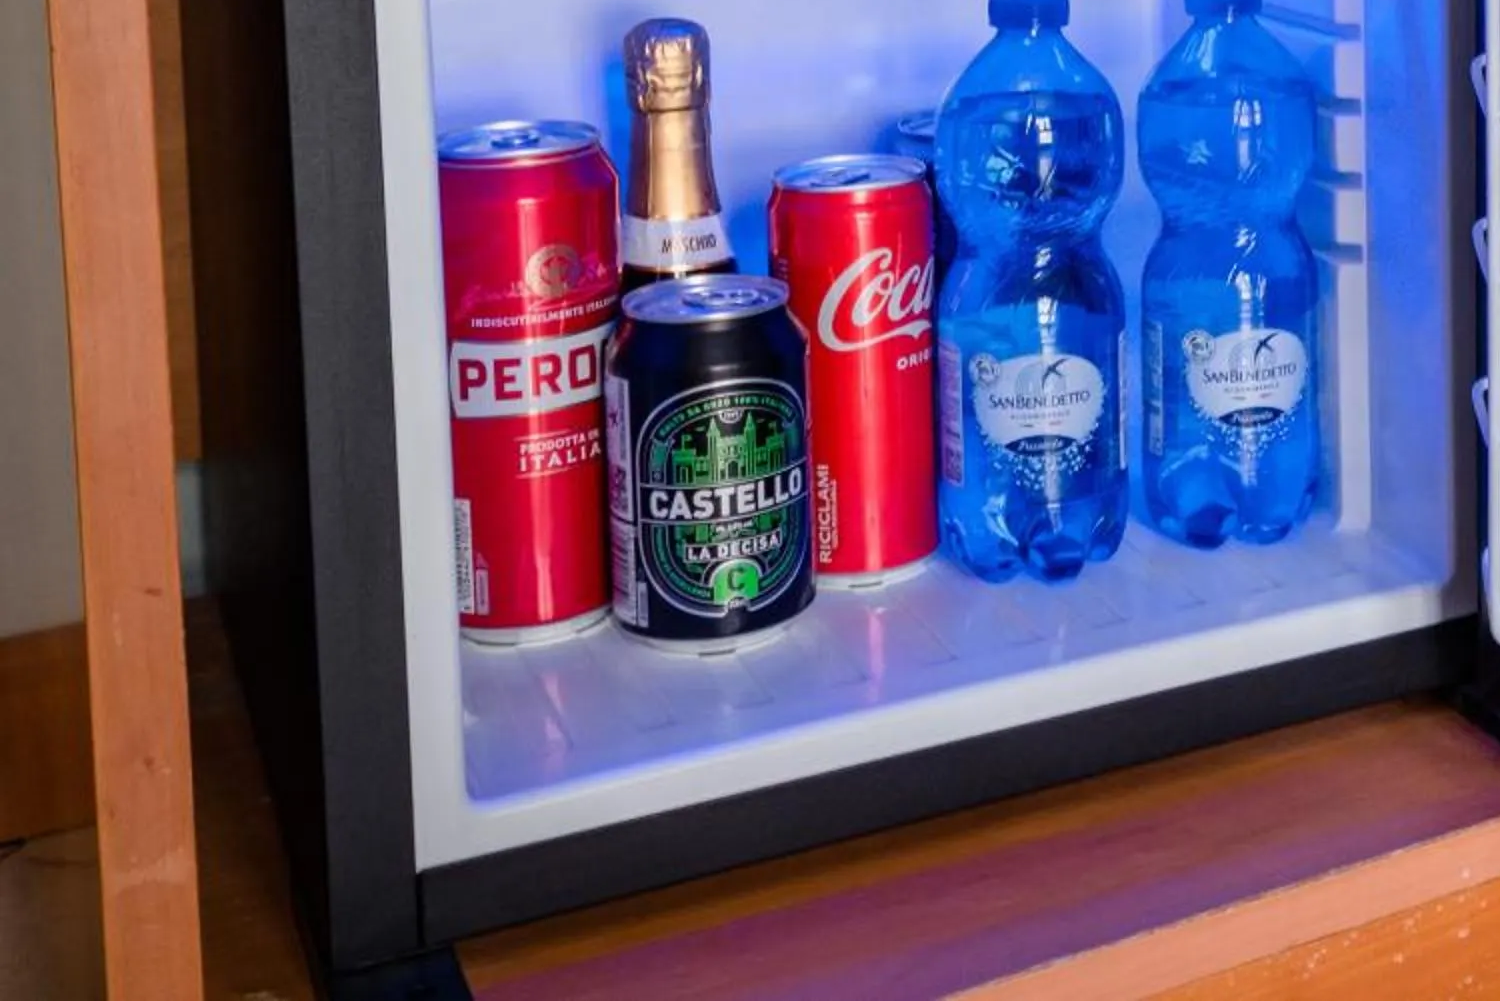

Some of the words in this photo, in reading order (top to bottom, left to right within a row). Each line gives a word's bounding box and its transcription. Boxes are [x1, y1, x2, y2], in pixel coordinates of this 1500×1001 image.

[661, 233, 717, 254] MSCHIO
[458, 343, 597, 402] PERO
[519, 441, 601, 472] ITALIA
[650, 469, 802, 519] CASTELLO
[816, 464, 832, 564] RICICLAMI
[687, 546, 711, 561] LA
[717, 532, 781, 558] DECISA
